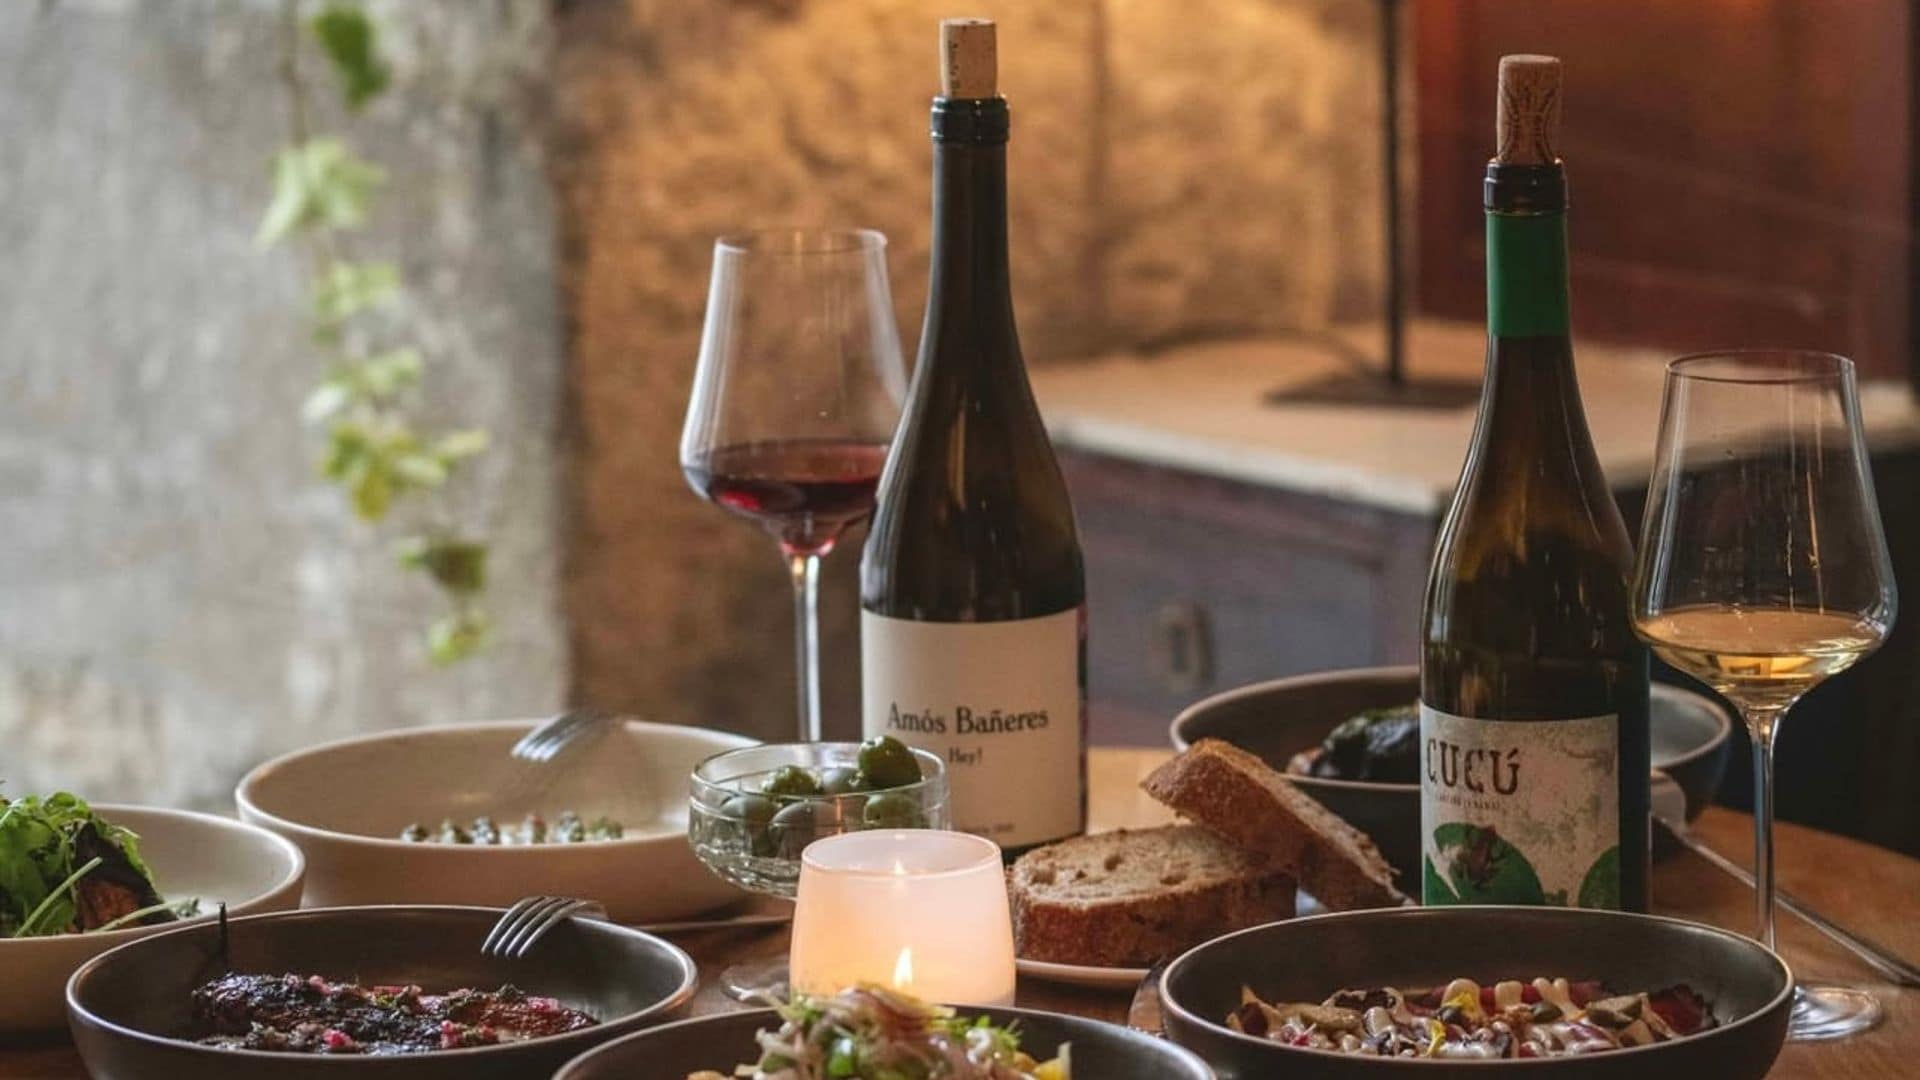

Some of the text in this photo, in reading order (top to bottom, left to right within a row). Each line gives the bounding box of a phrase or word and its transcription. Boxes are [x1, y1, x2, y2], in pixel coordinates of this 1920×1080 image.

[887, 702, 1049, 735] Amós Bañeres
[1426, 738, 1521, 796] CUCÚ
